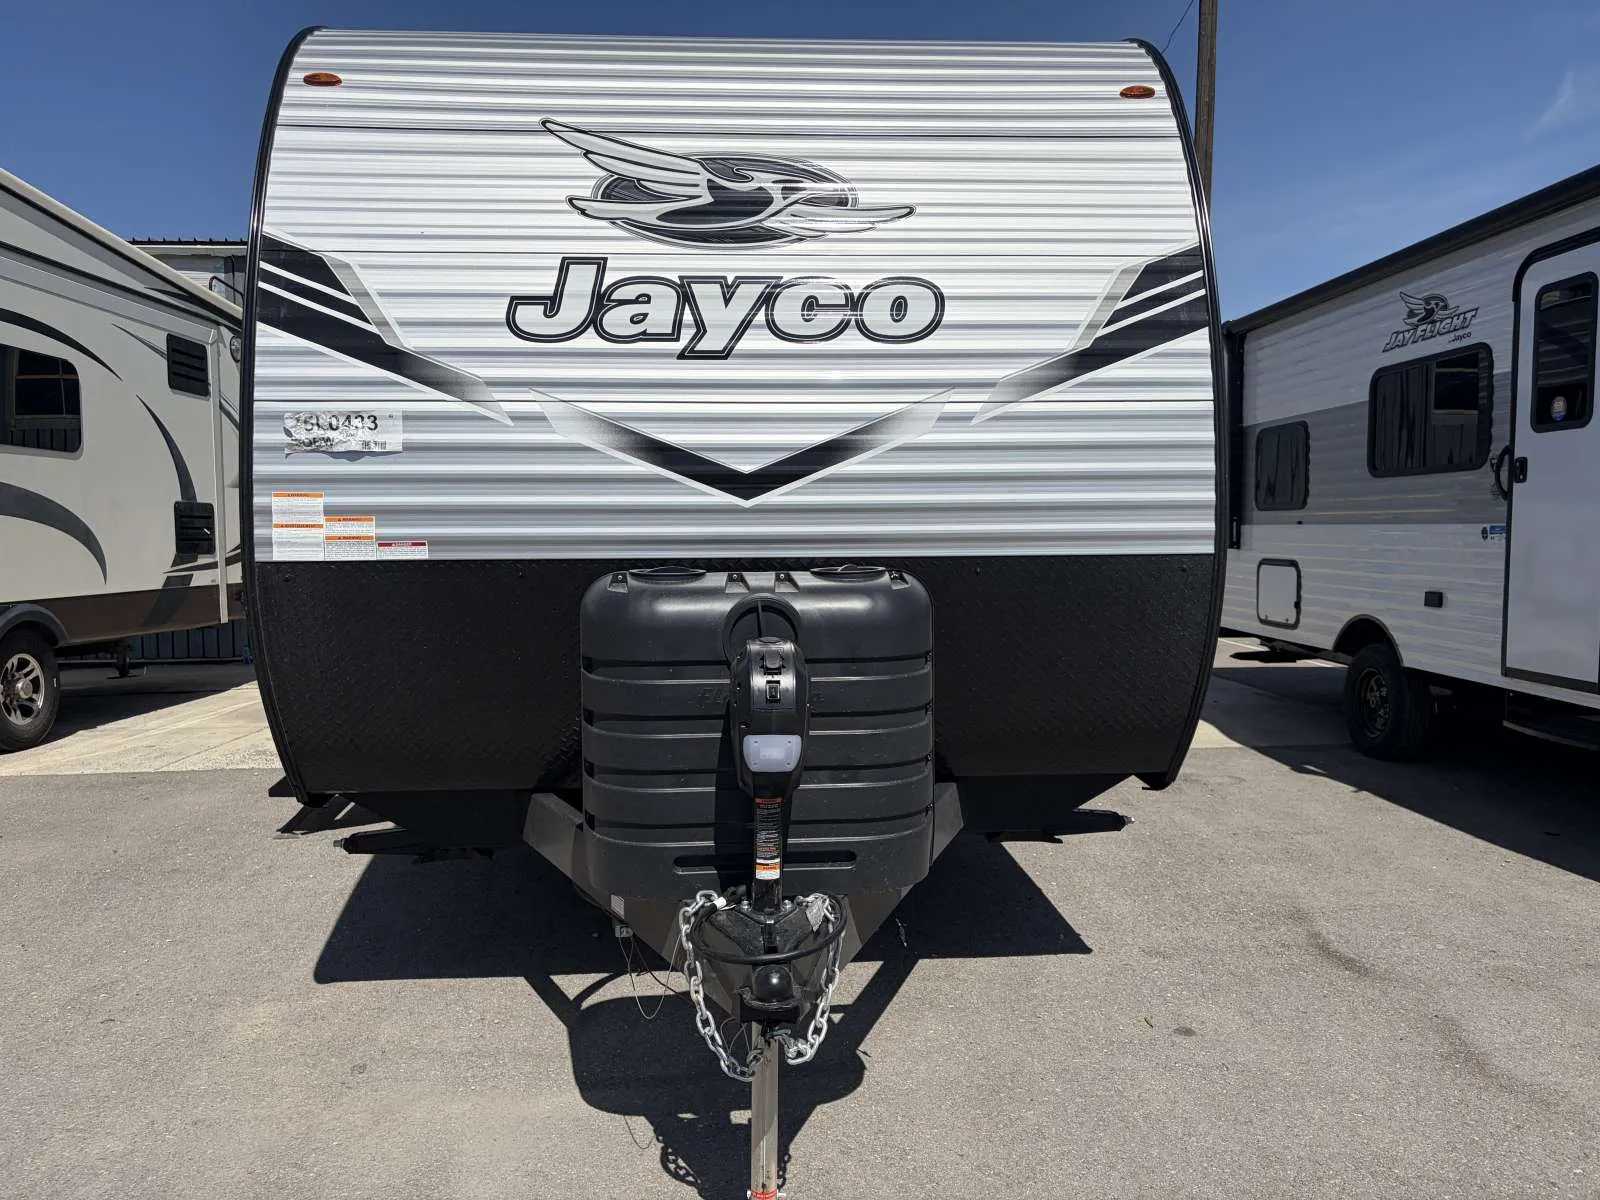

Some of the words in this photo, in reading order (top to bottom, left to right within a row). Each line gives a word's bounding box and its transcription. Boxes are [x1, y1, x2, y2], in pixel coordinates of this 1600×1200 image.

[505, 256, 946, 360] Jayco
[1382, 327, 1420, 353] JAY
[1414, 307, 1479, 343] FLIGHT
